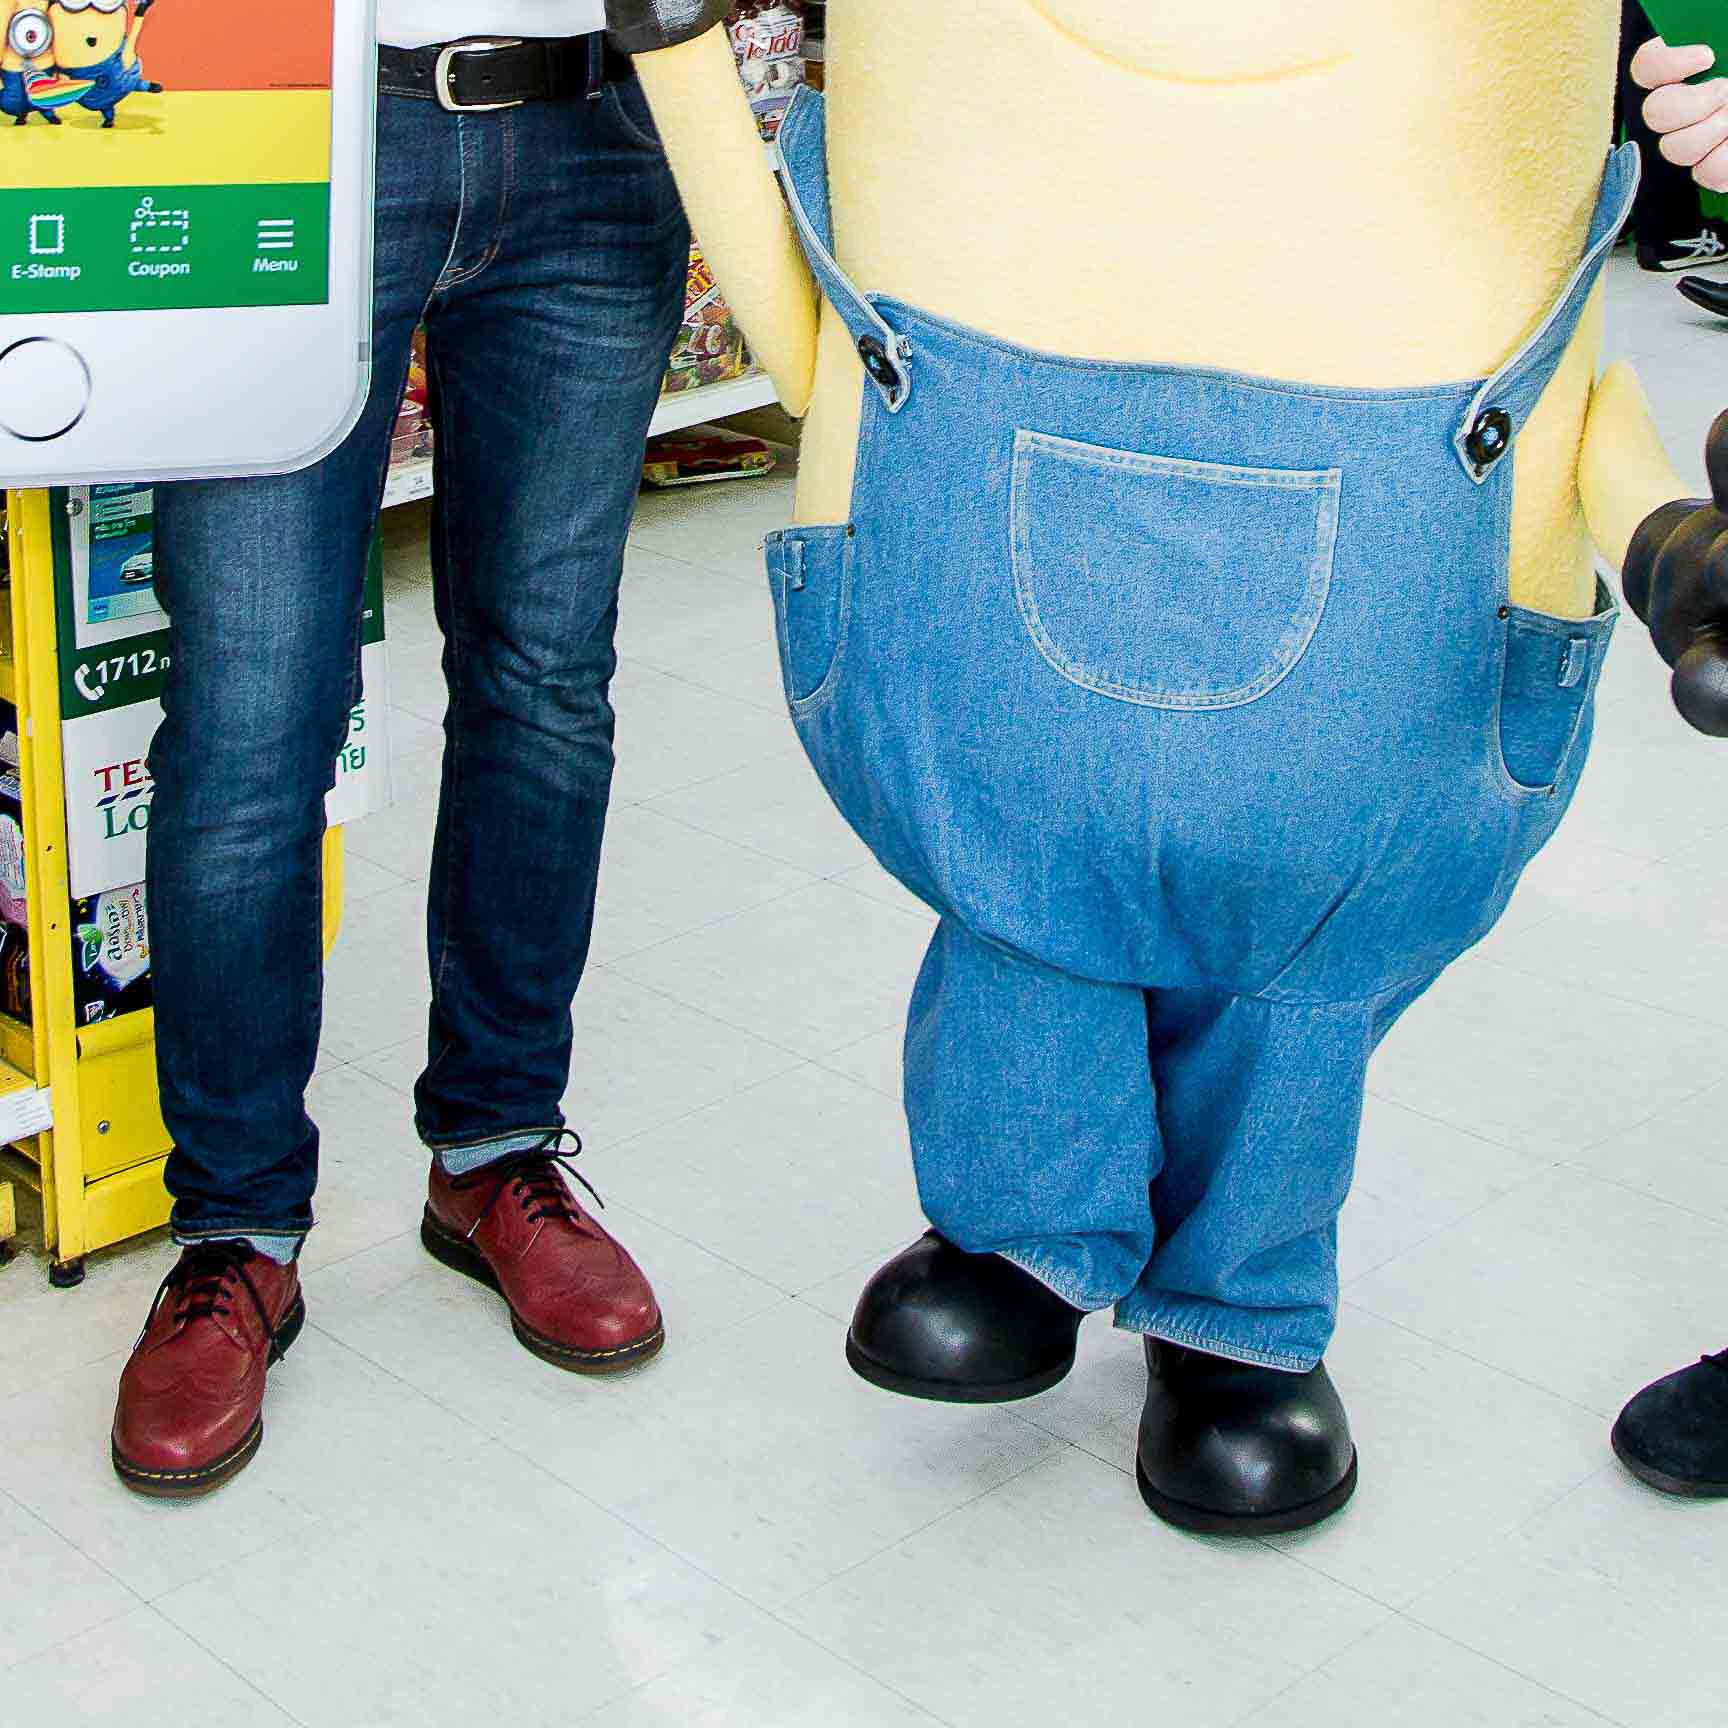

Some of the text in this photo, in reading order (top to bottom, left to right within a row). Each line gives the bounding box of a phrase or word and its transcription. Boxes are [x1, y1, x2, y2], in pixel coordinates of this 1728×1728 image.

[12, 261, 82, 282] E-Stamp
[128, 259, 192, 279] Coupon
[253, 255, 300, 273] Menu
[98, 649, 156, 684] 1712
